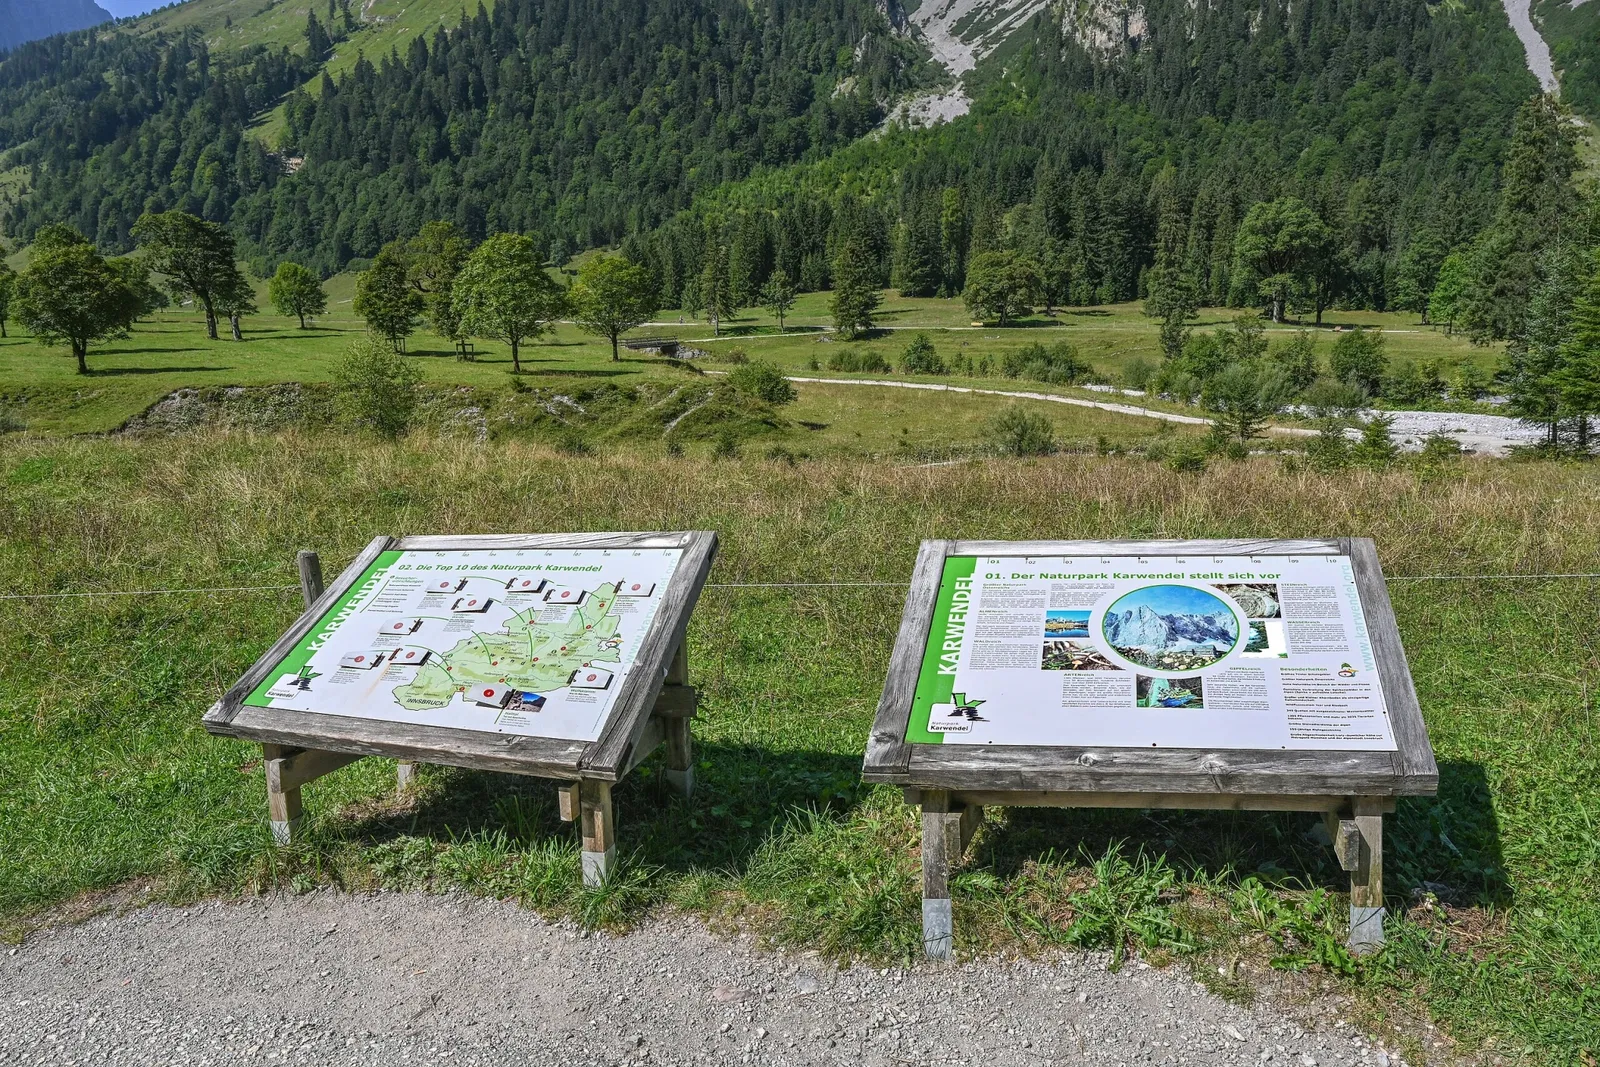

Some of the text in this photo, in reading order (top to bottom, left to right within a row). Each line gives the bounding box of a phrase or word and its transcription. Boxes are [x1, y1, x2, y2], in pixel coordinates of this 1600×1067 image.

[435, 564, 453, 572] Top
[489, 564, 543, 573] Naturpark
[545, 564, 603, 572] Karwendel
[985, 572, 1006, 580] 01.
[1011, 572, 1035, 580] Der
[1039, 572, 1108, 581] Naturpark
[1113, 572, 1185, 580] Karwendel
[1189, 572, 1224, 580] stellt
[1228, 572, 1255, 580] sich
[306, 566, 391, 651] KARWENDEL
[937, 572, 975, 675] KARWENDEL
[405, 698, 445, 706] INNSBRUCK
